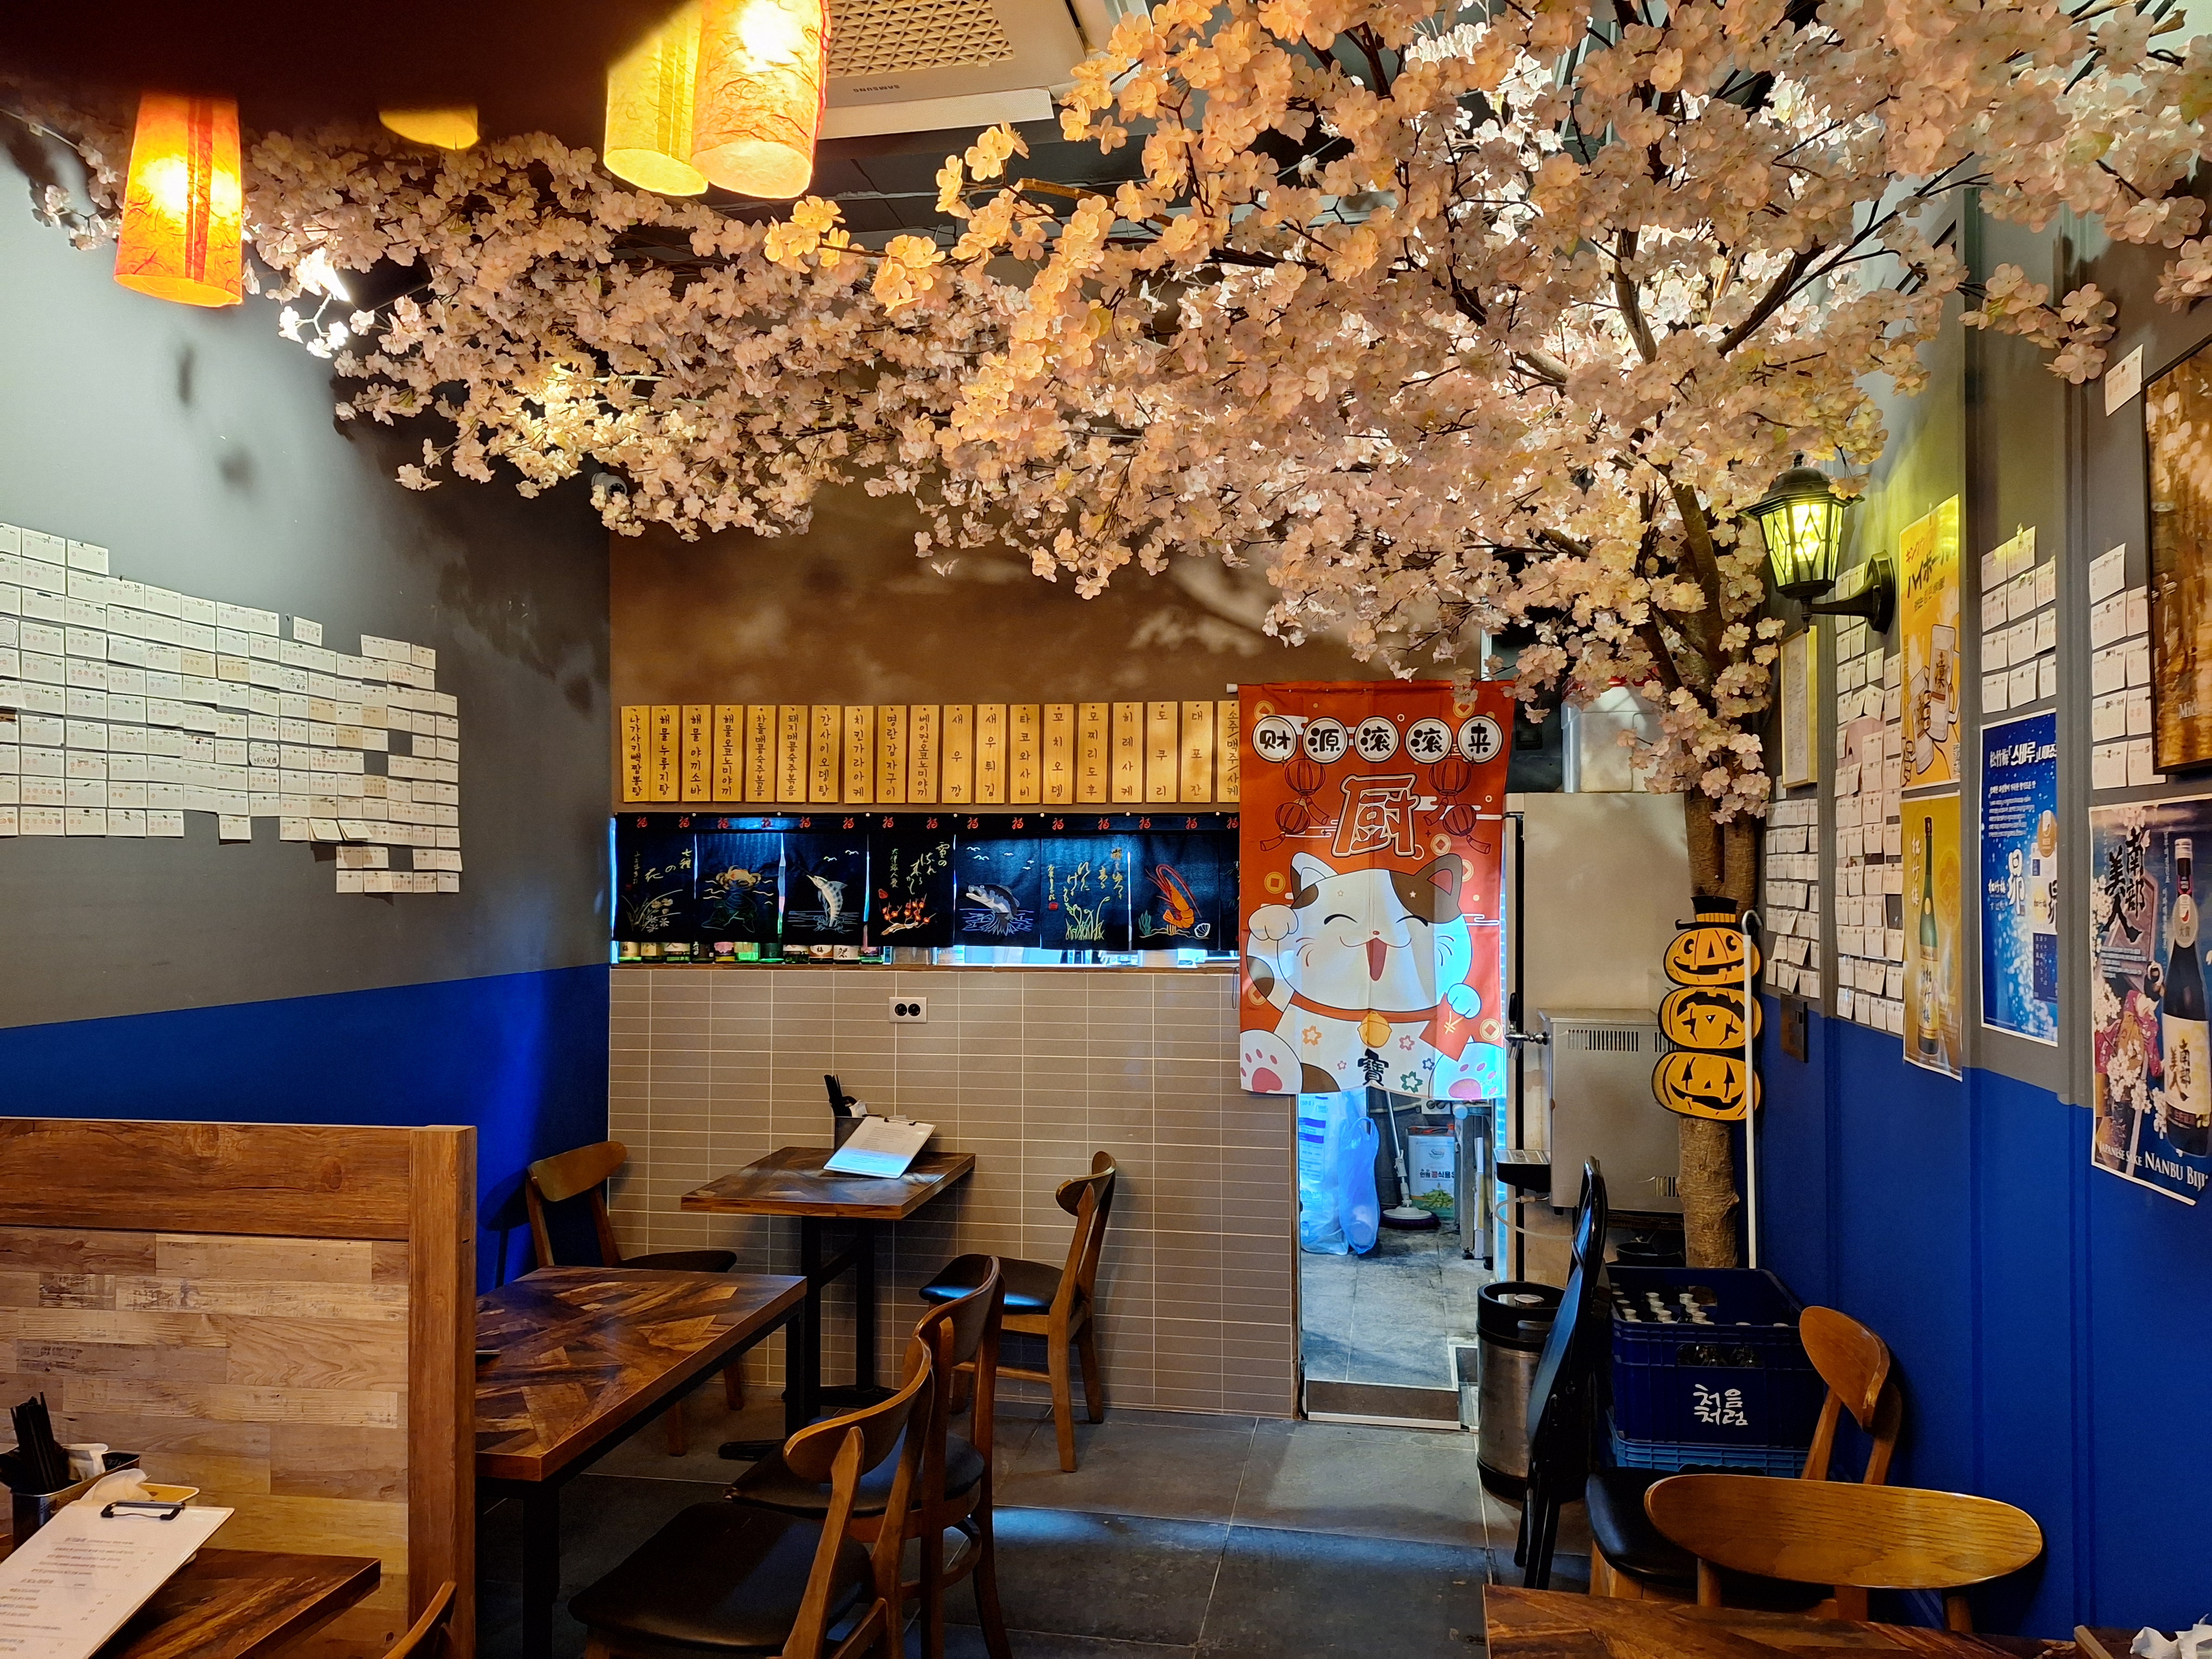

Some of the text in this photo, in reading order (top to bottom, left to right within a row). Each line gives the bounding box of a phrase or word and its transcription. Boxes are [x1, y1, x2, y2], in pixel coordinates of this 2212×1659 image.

[853, 85, 900, 93] SAMSUNG
[659, 715, 671, 796] 해물누룽지탕
[691, 714, 702, 795] 해물야끼소바
[722, 715, 735, 796] 해물오코노미야끼
[755, 715, 767, 797] 차돌매콤숙주볶음
[787, 714, 799, 796] 돼지매콤숙주볶음
[819, 715, 832, 797] 간사이오뎅탕
[886, 715, 898, 797] 명란감자구이
[918, 714, 930, 796] 베이컨오코노미야끼
[951, 714, 963, 798] 새우깡
[985, 713, 997, 798] 새우튀김
[1020, 713, 1032, 797] 타코와사비
[1052, 713, 1064, 798] 꼬치오뎅
[1086, 712, 1099, 796] 모찌리도후
[1122, 712, 1134, 795] 히레사케
[1156, 711, 1168, 796] 도쿠리
[1192, 711, 1203, 796] 대포잔
[1259, 722, 1491, 754] 财源滚滚来
[1333, 773, 1421, 858] 厨
[2144, 1150, 2183, 1181] NANBU
[1693, 1384, 1742, 1408] 처음
[1694, 1406, 1748, 1425] 처럼
